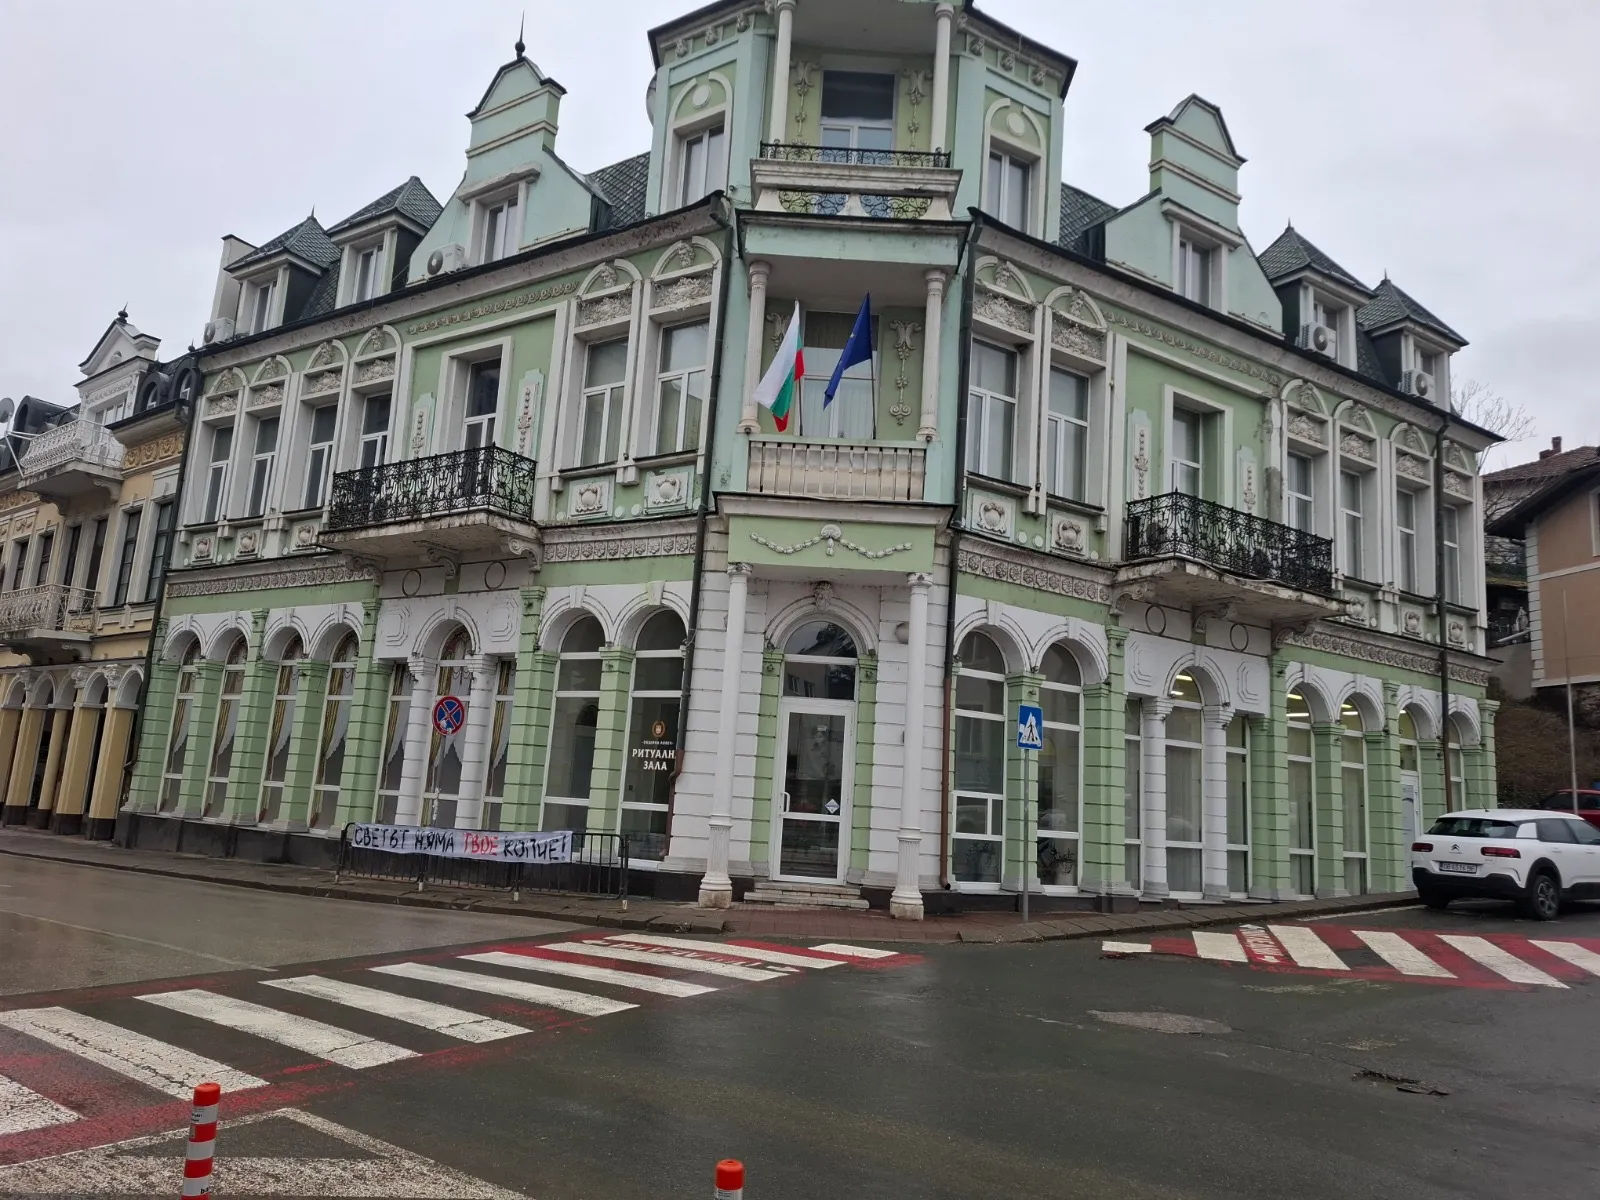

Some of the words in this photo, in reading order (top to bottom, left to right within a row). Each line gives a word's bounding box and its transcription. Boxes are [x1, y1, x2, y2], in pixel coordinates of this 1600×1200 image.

[632, 749, 676, 759] РИТУАЛН
[643, 761, 667, 770] ЗАЛА
[414, 829, 454, 853] НЯМА
[464, 832, 499, 856] ТВОЕ
